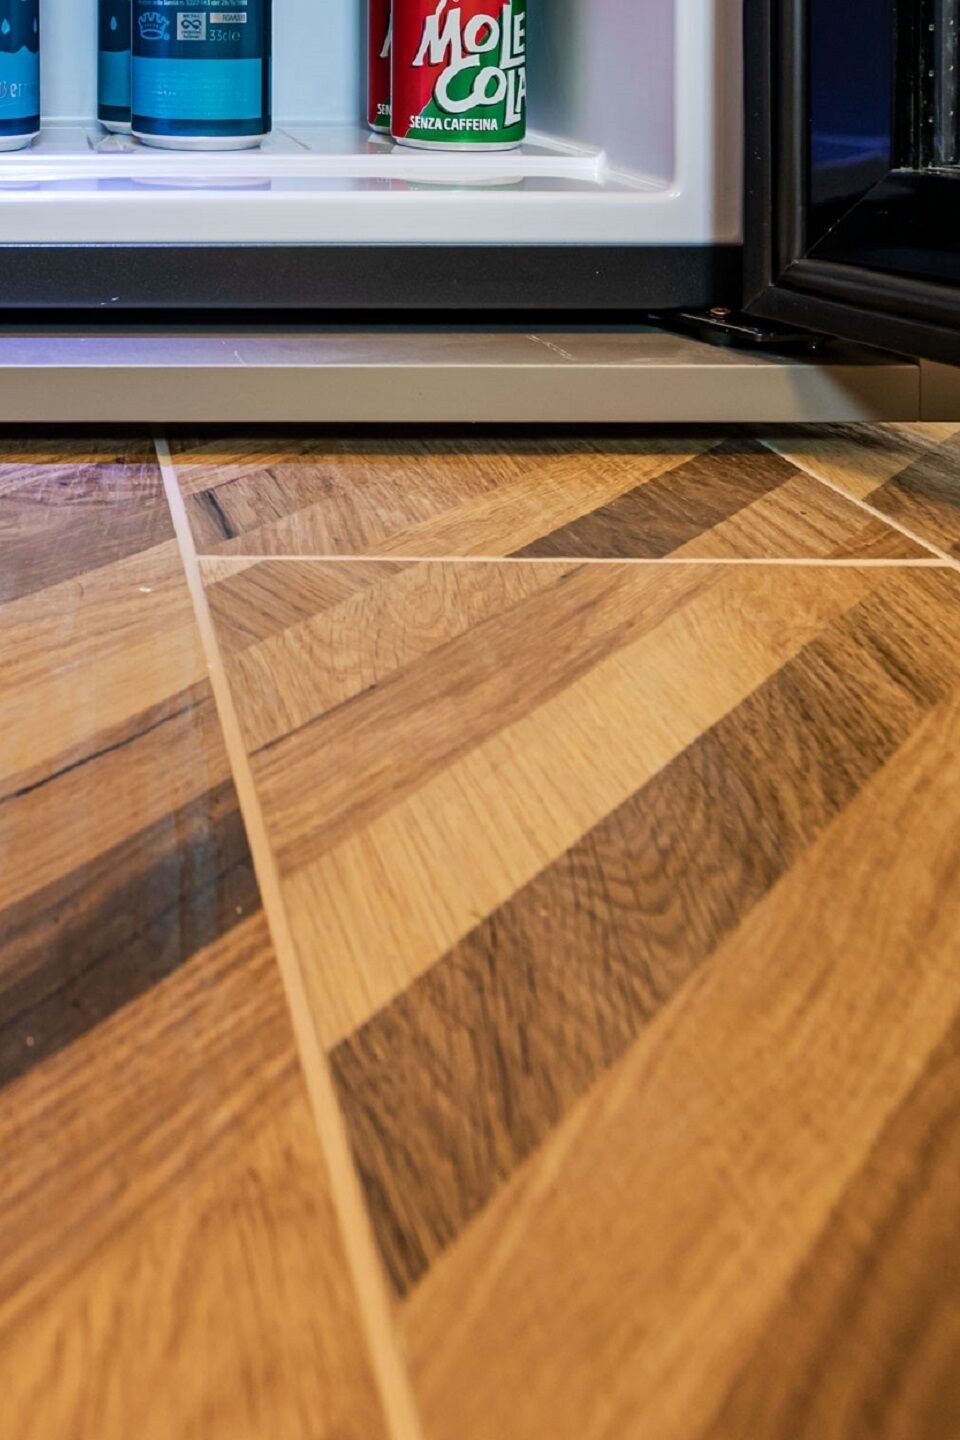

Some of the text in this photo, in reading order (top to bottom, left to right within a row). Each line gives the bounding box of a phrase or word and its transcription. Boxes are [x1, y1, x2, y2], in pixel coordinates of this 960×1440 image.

[412, 3, 525, 69] MOLE
[410, 115, 497, 131] SENZA CAFFEINA
